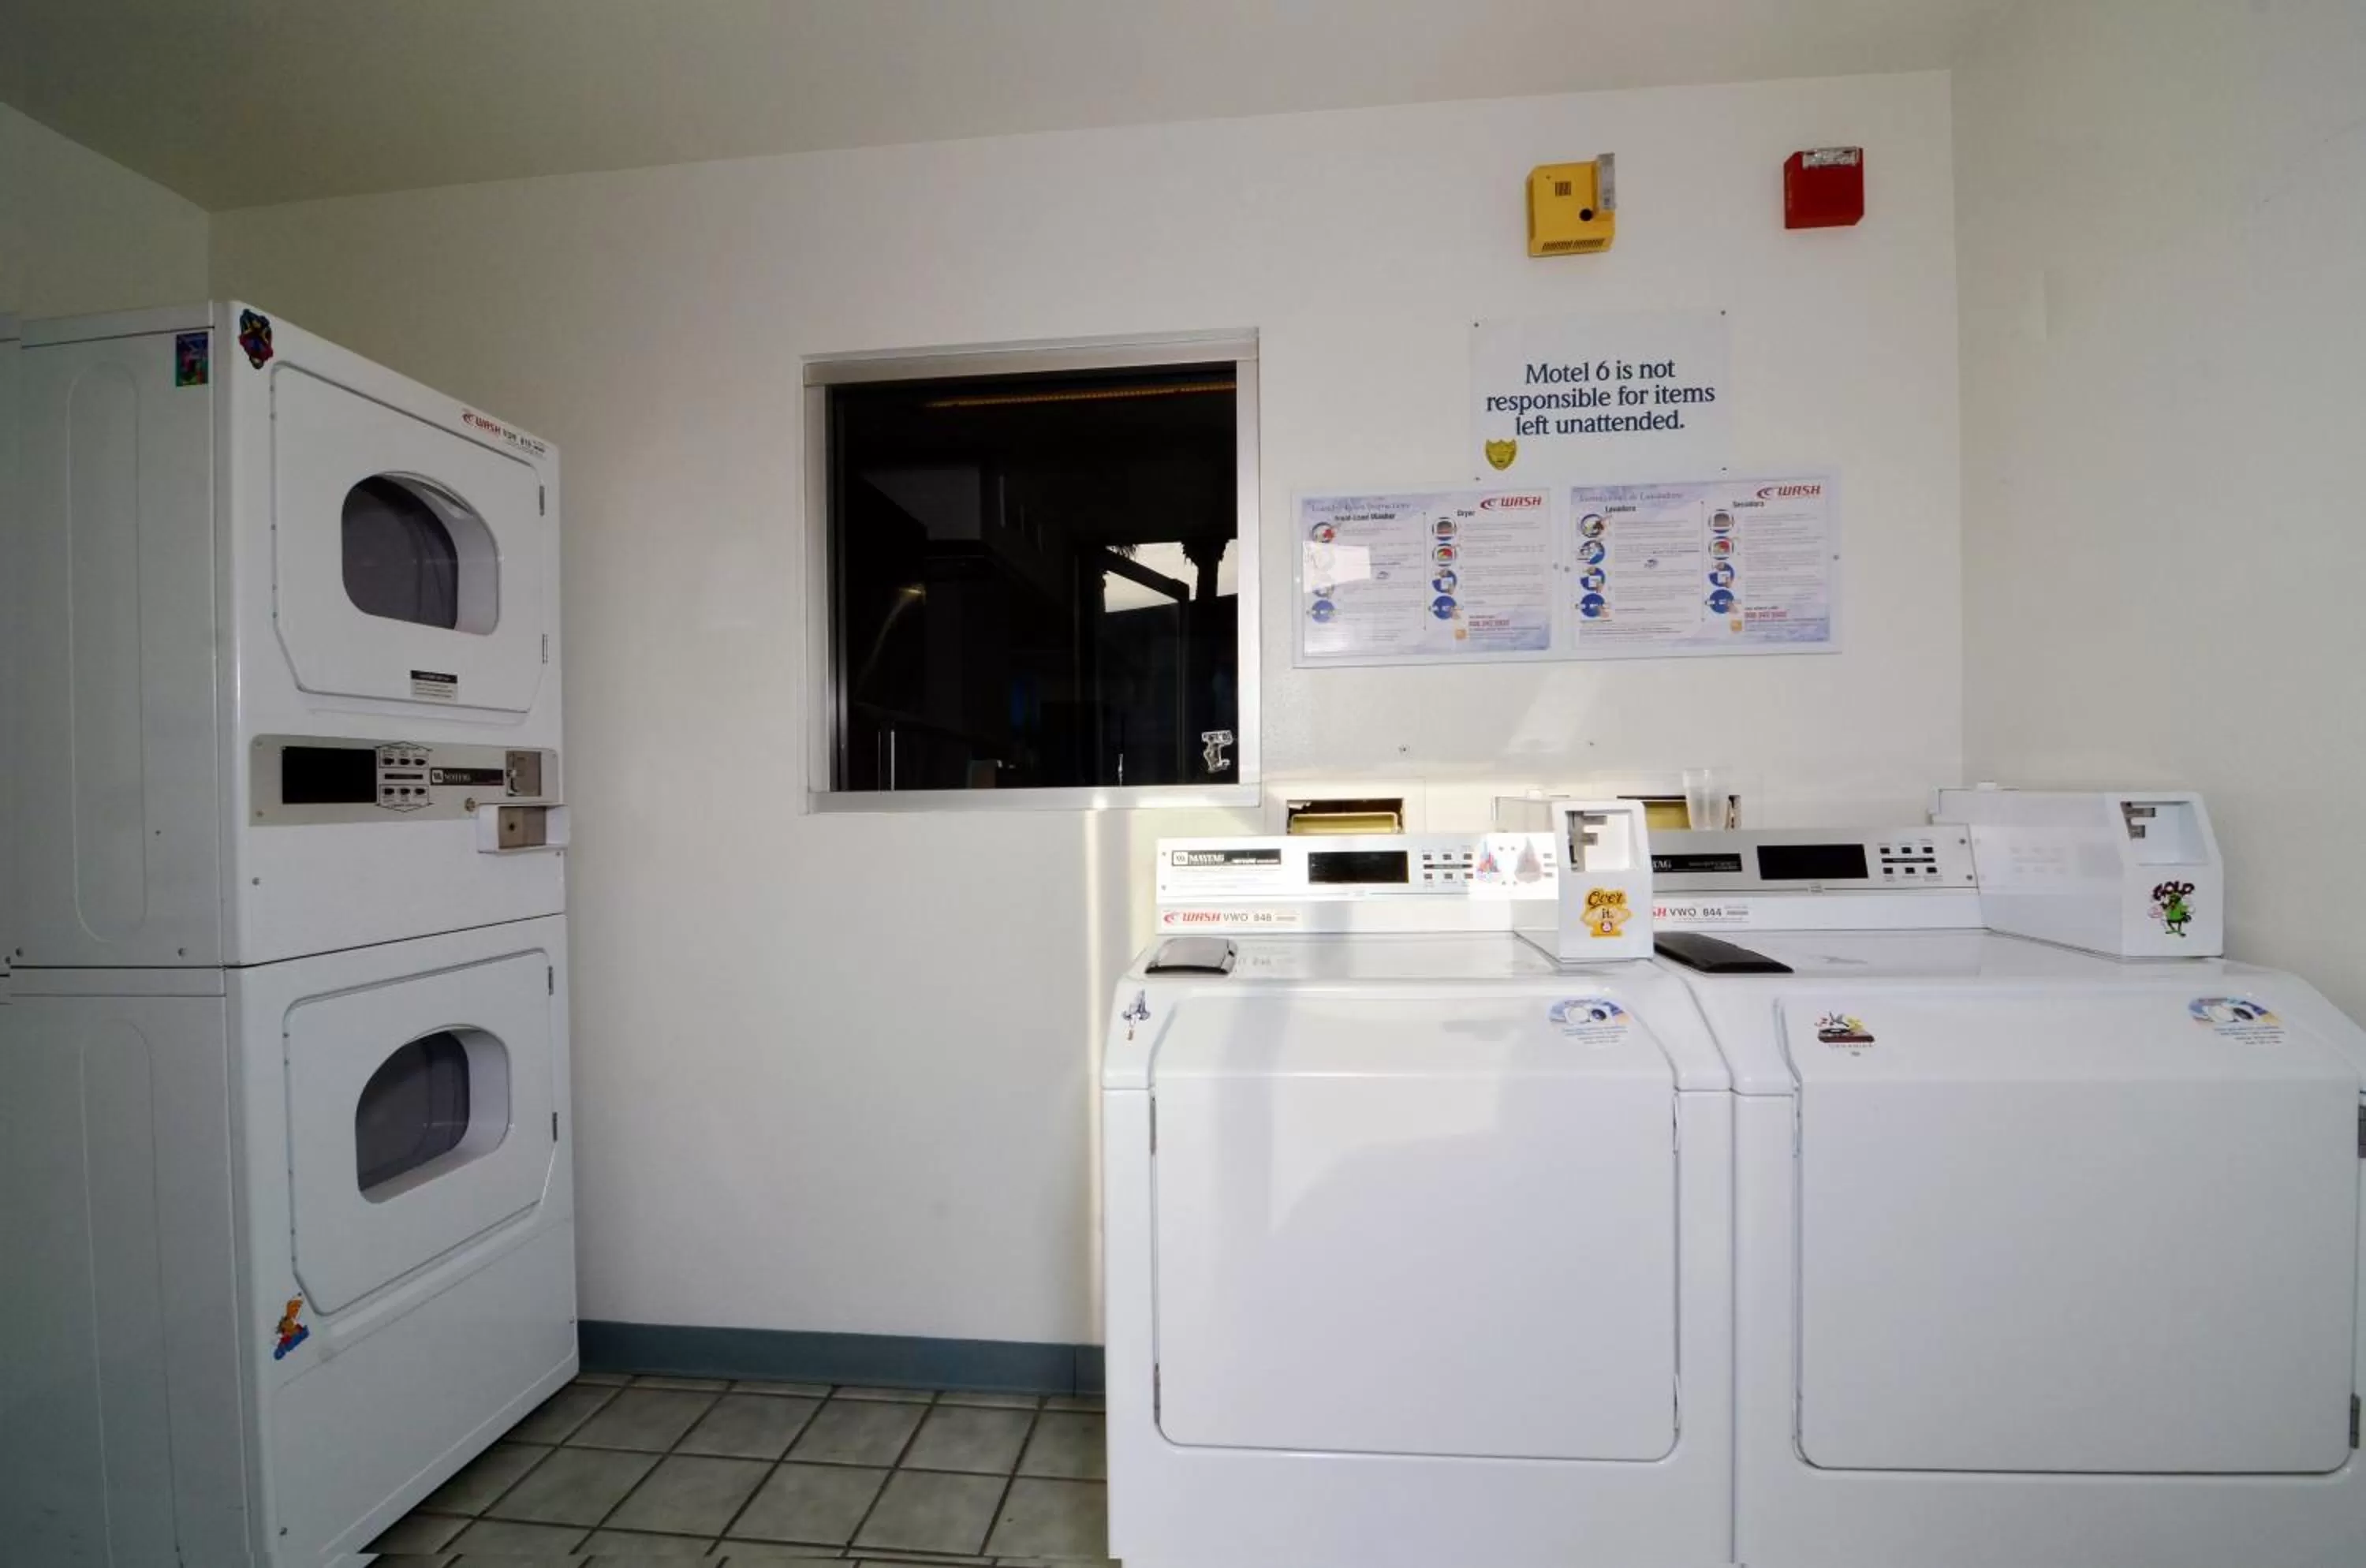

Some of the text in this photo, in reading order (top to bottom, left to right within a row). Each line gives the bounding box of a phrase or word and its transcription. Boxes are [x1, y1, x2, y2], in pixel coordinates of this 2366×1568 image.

[1525, 360, 1676, 384] Motel 6 is not
[1487, 384, 1715, 415] responsible for items
[1516, 410, 1685, 435] left unattended.
[1777, 485, 1820, 496] WASH
[1501, 495, 1542, 507] WASH
[1182, 912, 1221, 922] WASH
